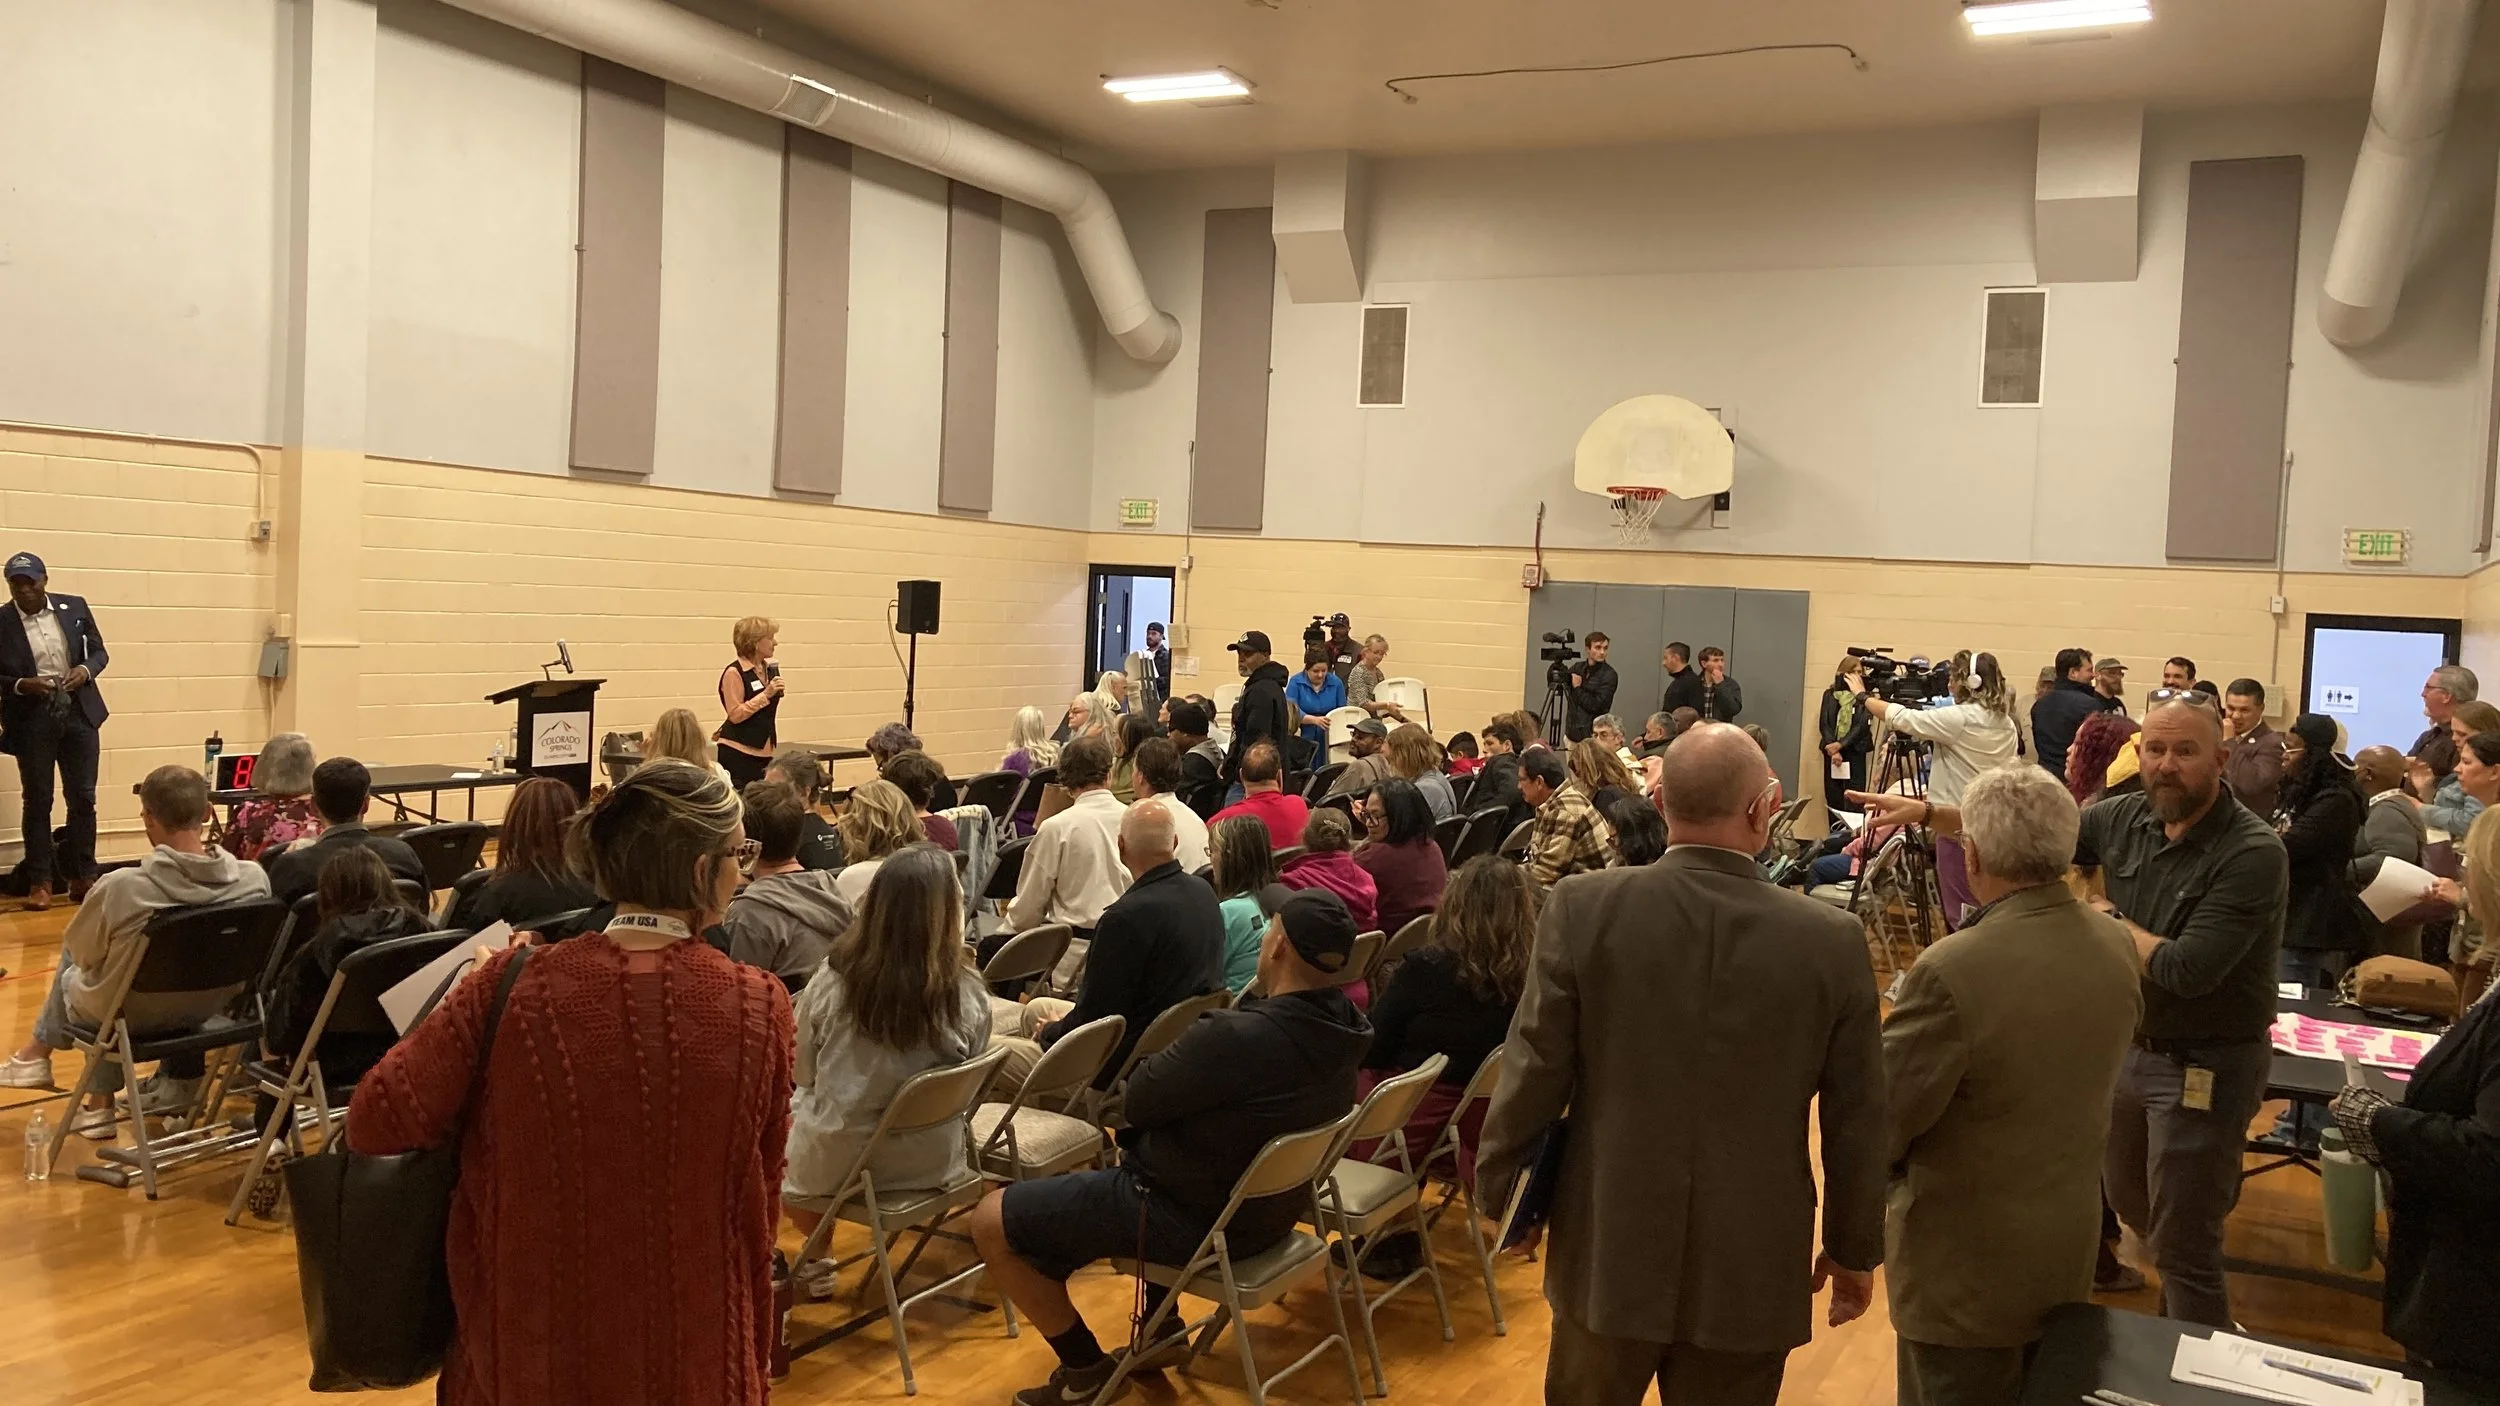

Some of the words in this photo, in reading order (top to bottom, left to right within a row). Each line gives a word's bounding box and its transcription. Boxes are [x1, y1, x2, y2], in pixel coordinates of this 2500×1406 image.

[1128, 502, 1148, 519] EXIT
[2358, 534, 2394, 555] EXIT
[541, 735, 580, 747] COLORADO
[549, 744, 572, 752] SPRINGS
[233, 756, 254, 788] 8
[611, 916, 634, 927] TEAM
[637, 916, 658, 928] USA
